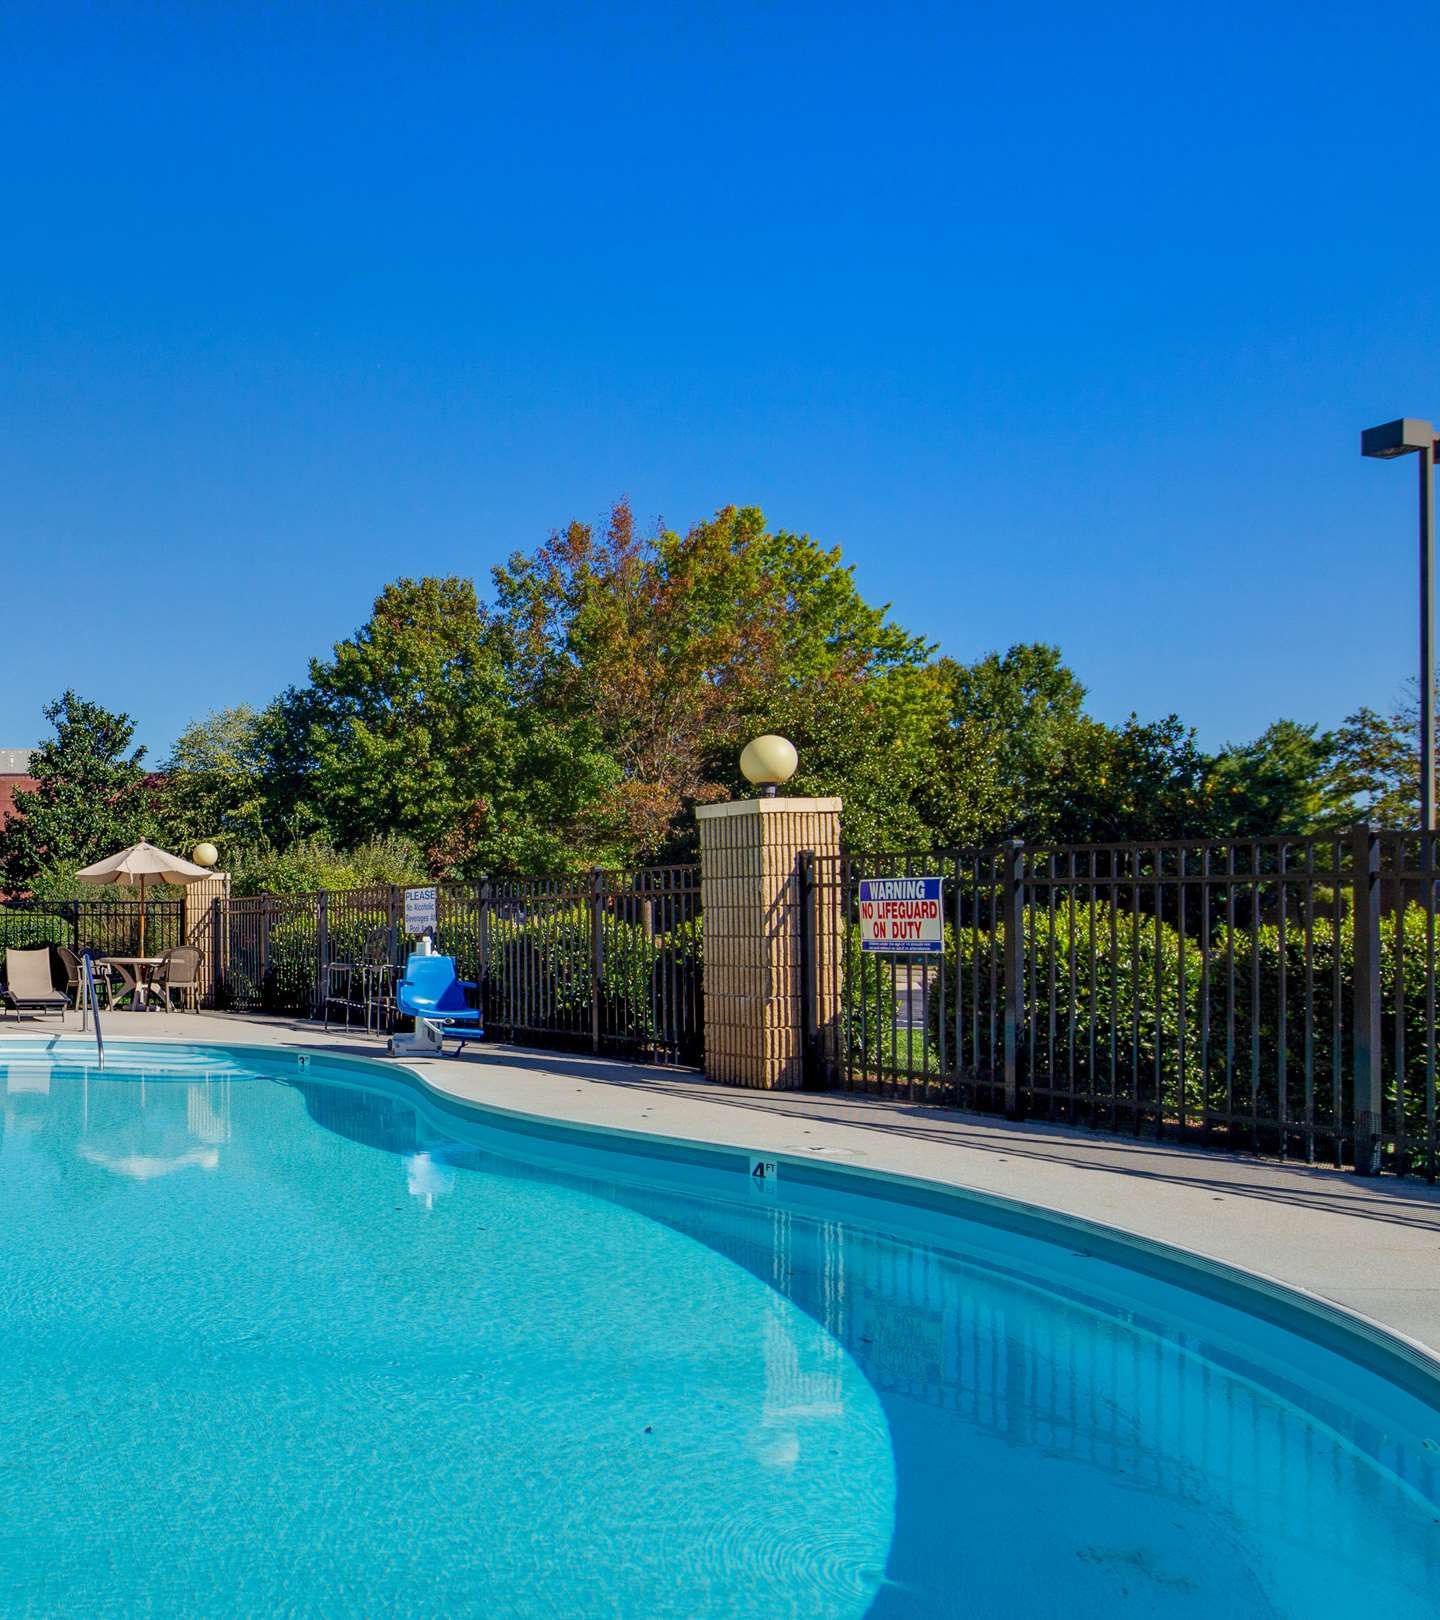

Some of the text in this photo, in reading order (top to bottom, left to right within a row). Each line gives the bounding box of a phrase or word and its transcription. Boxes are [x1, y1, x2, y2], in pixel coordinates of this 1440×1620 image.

[405, 890, 435, 900] PLEASE
[869, 881, 926, 900] WARNING
[862, 901, 938, 919] NO LIFEGUARD
[873, 921, 922, 939] ON DUTY
[752, 1161, 777, 1178] 4 FT
